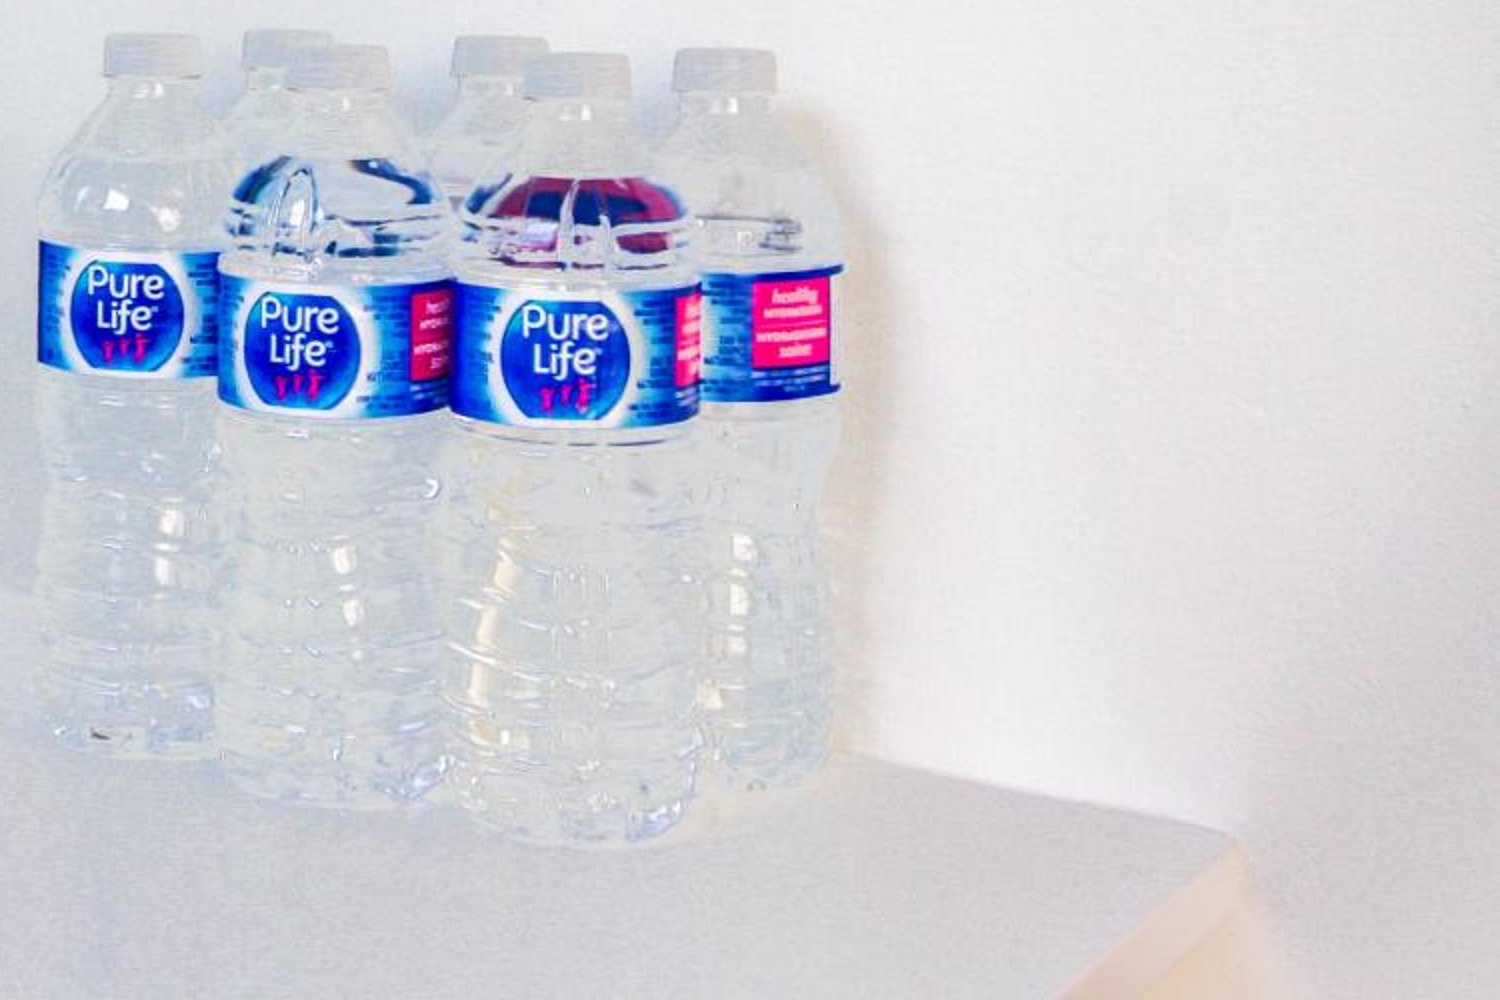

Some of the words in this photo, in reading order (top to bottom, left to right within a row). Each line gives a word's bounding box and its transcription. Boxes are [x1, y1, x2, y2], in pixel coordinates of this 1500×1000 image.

[87, 264, 165, 300] Pure
[97, 299, 152, 335] Life
[260, 296, 340, 334] Pure
[522, 304, 609, 341] Pure
[270, 333, 326, 371] Life
[533, 341, 597, 381] Life
